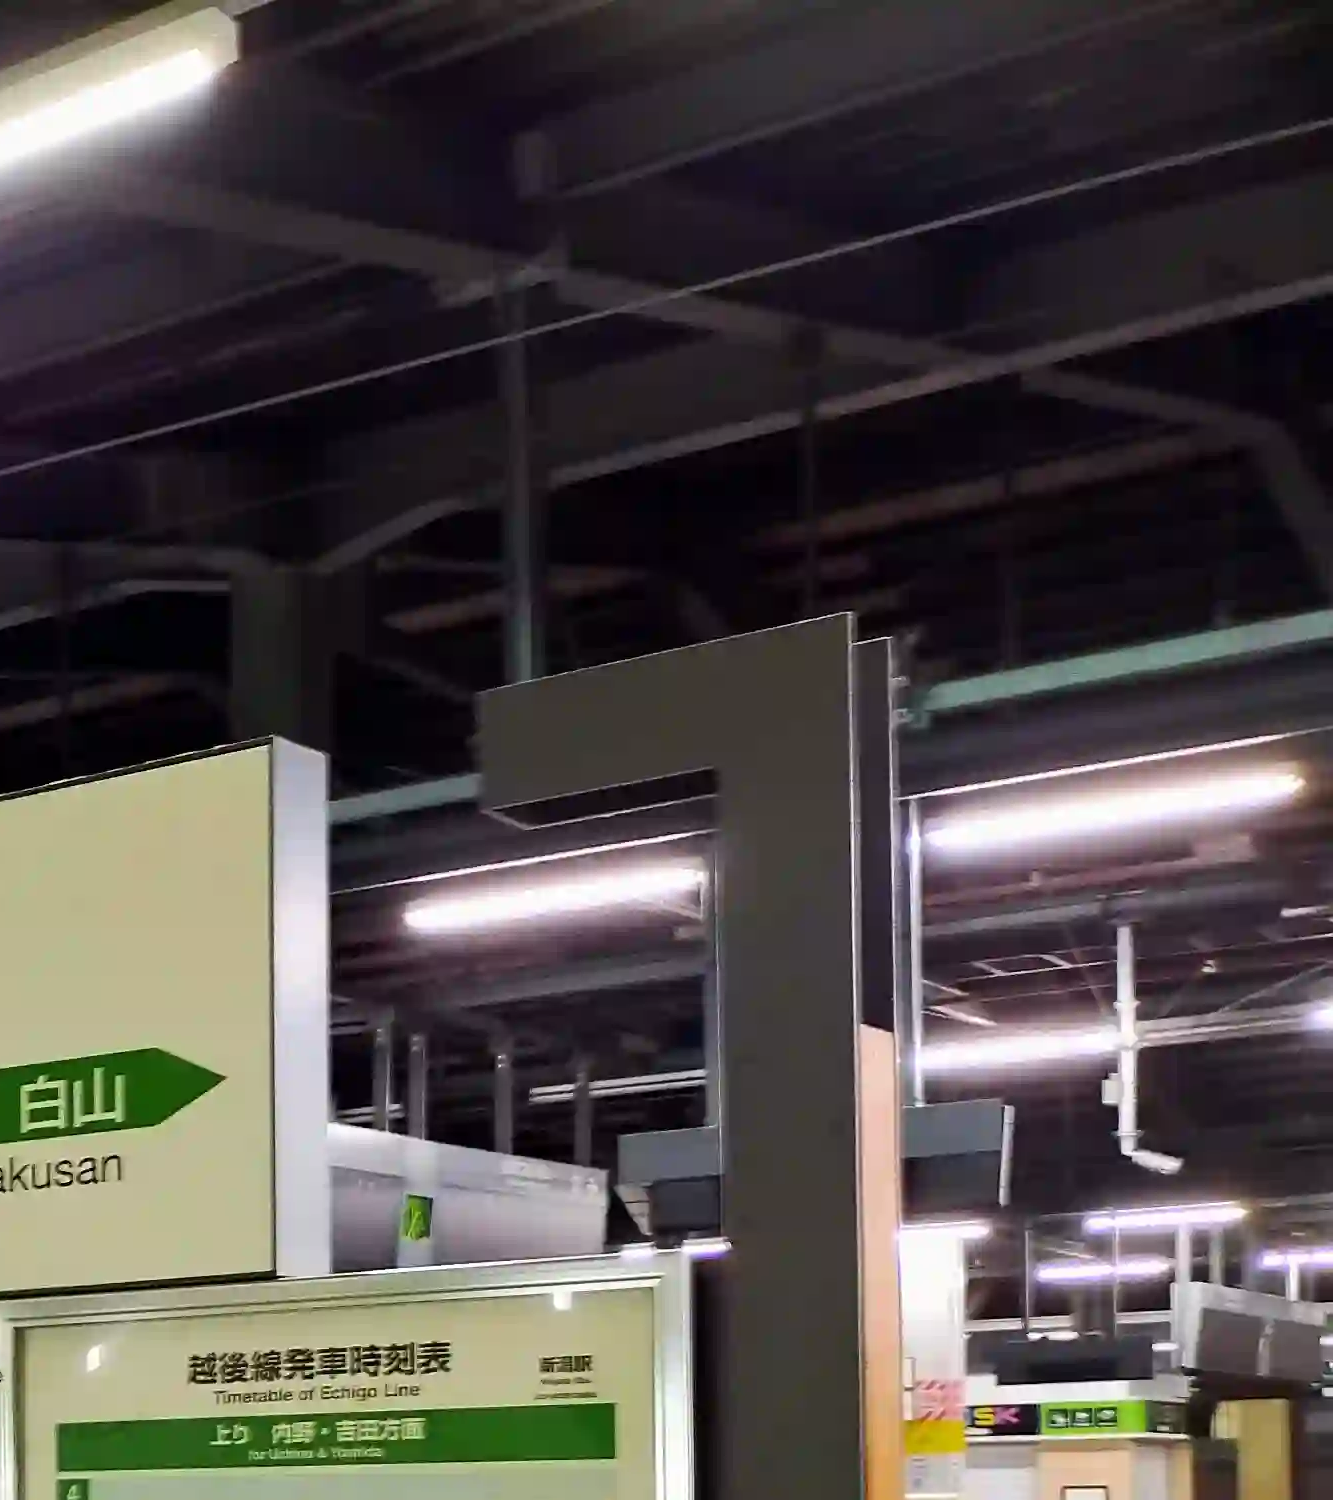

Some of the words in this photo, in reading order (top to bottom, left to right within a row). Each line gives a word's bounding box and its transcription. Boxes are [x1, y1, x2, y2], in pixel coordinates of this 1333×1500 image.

[20, 1067, 126, 1134] 白山
[187, 1341, 452, 1385] 越後線発車時刻表
[213, 1387, 293, 1405] Timetable
[299, 1386, 316, 1402] of
[321, 1384, 378, 1402] Echigo
[384, 1382, 421, 1397] Line
[209, 1423, 250, 1446] 上り
